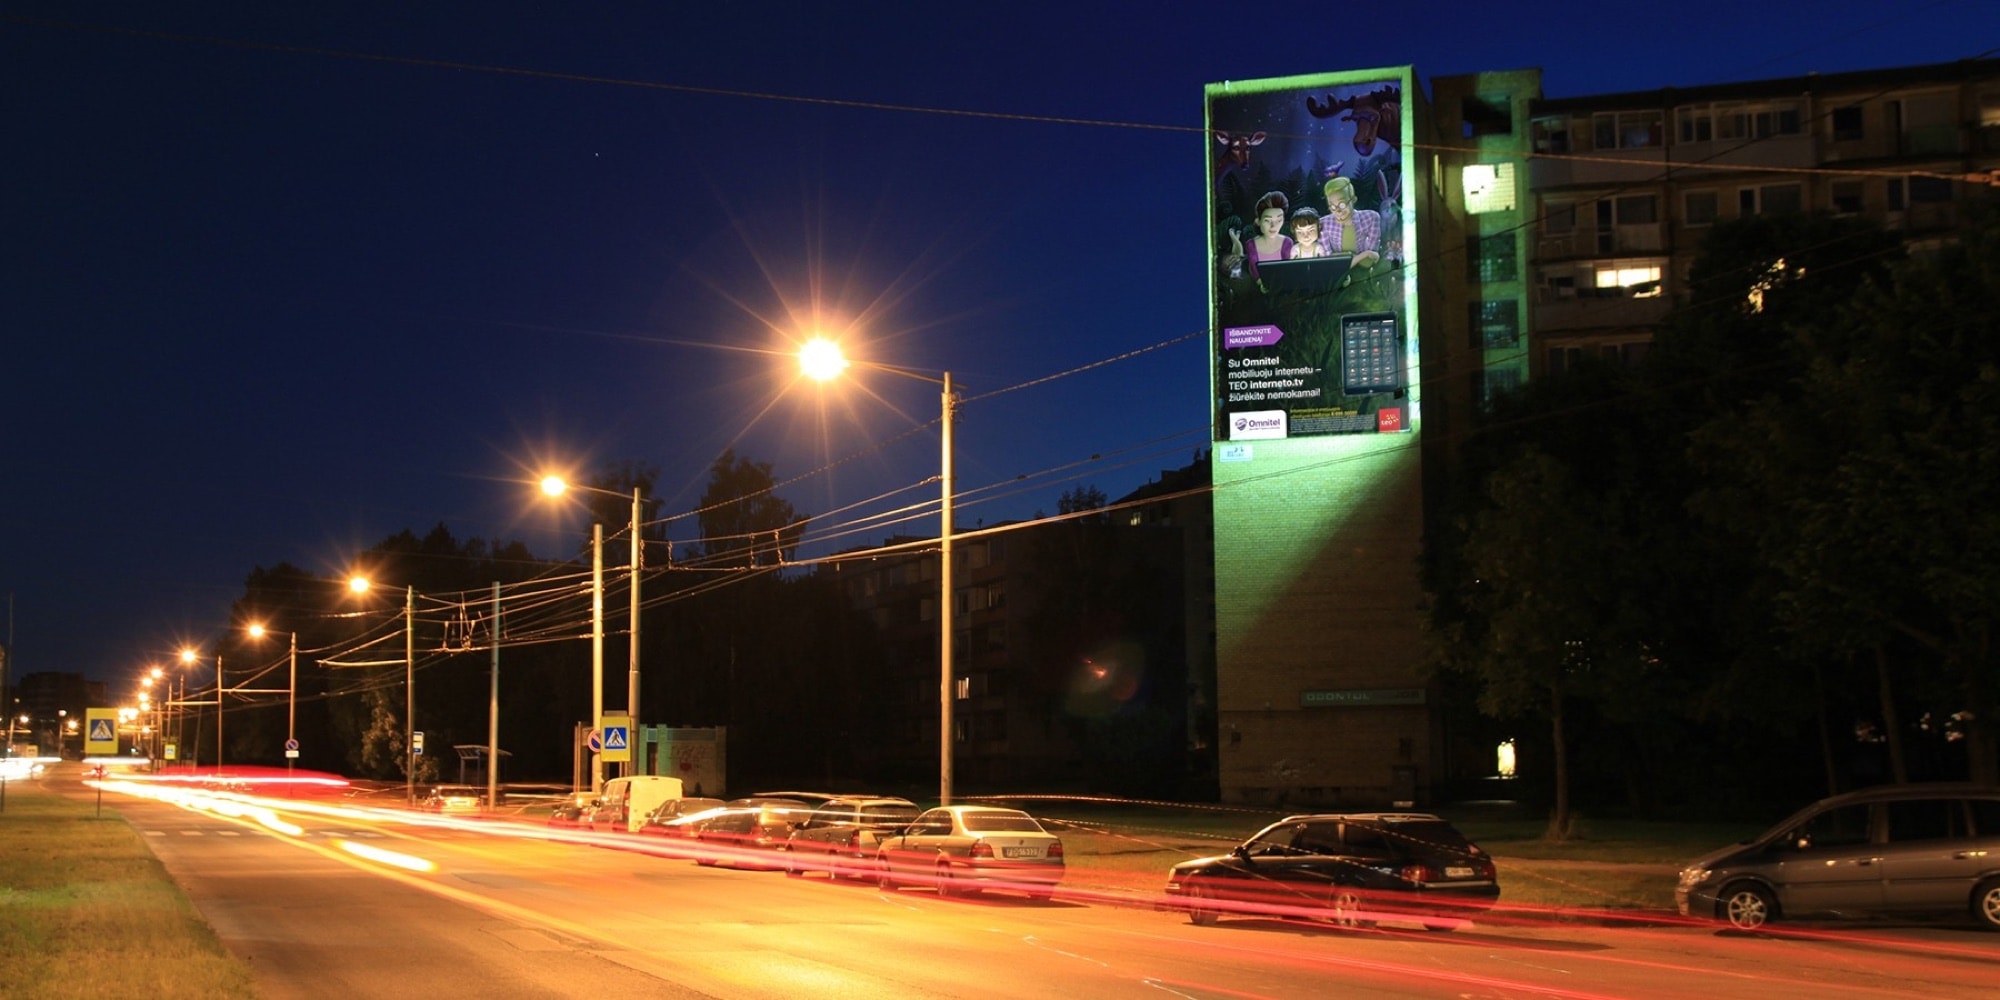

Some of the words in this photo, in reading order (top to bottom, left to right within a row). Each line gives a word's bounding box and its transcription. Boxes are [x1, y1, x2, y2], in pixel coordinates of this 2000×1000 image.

[1228, 359, 1241, 368] Su
[1242, 356, 1280, 367] Omnitel
[1228, 370, 1273, 380] mobiliuoju
[1275, 366, 1314, 377] internetu
[1228, 381, 1249, 391] TEO
[1250, 378, 1304, 389] interneto.tv
[1228, 391, 1266, 402] žiūrėkite
[1267, 388, 1321, 400] nemokamai!
[1249, 418, 1280, 427] Omnitel
